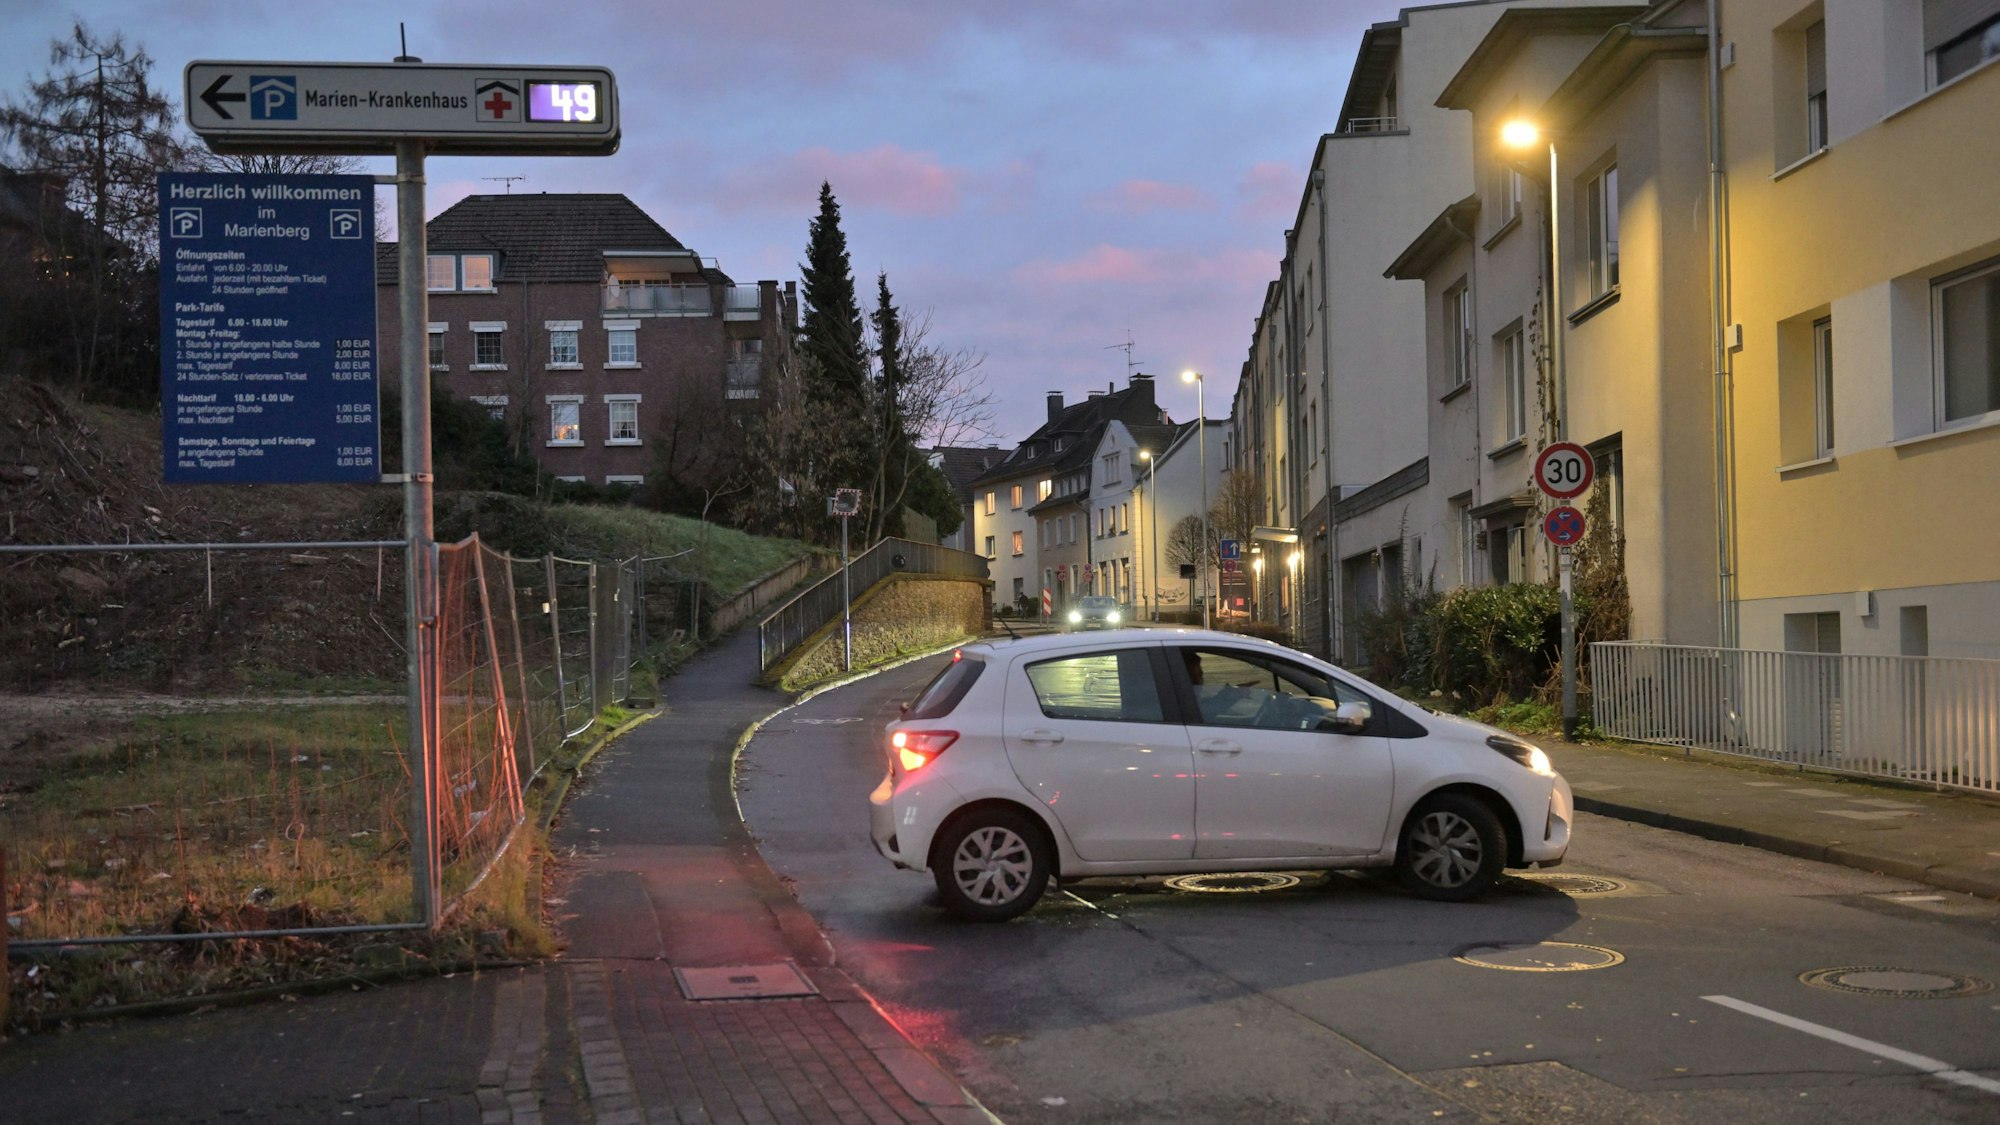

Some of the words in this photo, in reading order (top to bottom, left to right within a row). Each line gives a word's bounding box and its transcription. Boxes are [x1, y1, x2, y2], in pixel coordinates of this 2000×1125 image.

[265, 90, 285, 117] P
[305, 89, 468, 109] Marien-Krankenhaus
[551, 85, 596, 121] 49
[170, 183, 246, 199] Herzlich
[251, 185, 361, 200] willkommen
[258, 206, 276, 219] im
[181, 219, 193, 234] P
[224, 223, 310, 240] Marienberg
[340, 221, 352, 235] P
[175, 248, 245, 261] Öffnungszeiten
[176, 264, 205, 272] Einfahrt
[274, 264, 288, 272] Uhr
[176, 274, 208, 282] Ausfahrt
[213, 274, 246, 284] jederzeit
[212, 286, 222, 294] 24
[223, 286, 255, 294] Stunden
[175, 302, 225, 312] Park-Tarife
[176, 318, 215, 328] Tagestarif
[273, 318, 289, 327] Uhr
[176, 329, 207, 339] Montag
[185, 340, 213, 348] Stunde
[213, 340, 221, 350] je
[222, 340, 271, 350] angefangene
[271, 340, 293, 348] halbe
[294, 340, 321, 348] Stunde
[353, 339, 371, 347] EUR
[185, 351, 213, 359] Stunde
[213, 351, 221, 360] je
[222, 351, 271, 361] angefangene
[272, 351, 299, 359] Stunde
[353, 350, 371, 358] EUR
[196, 361, 234, 371] Tagestarif
[352, 361, 371, 370] EUR
[177, 372, 187, 380] 24
[188, 372, 239, 381] Stunden-Satz
[244, 372, 284, 380] verlorenes
[284, 372, 308, 380] Ticket
[353, 372, 372, 380] EUR
[177, 394, 217, 402] Nachttarif
[279, 394, 295, 402] Uhr
[177, 406, 186, 415] je
[186, 405, 235, 415] angefangene
[236, 404, 263, 413] Stunde
[353, 404, 372, 412] EUR
[197, 415, 234, 424] Nachttarif
[353, 415, 373, 423] EUR
[178, 437, 220, 448] Samstage,
[221, 437, 260, 447] Sonntage
[261, 437, 277, 445] und
[278, 437, 316, 447] Feiertage
[178, 449, 187, 458] je
[187, 448, 236, 458] angefangene
[237, 447, 264, 456] Stunde
[354, 447, 373, 455] EUR
[198, 458, 236, 469] Tagestarif
[354, 458, 373, 466] EUR
[1547, 458, 1581, 484] 30
